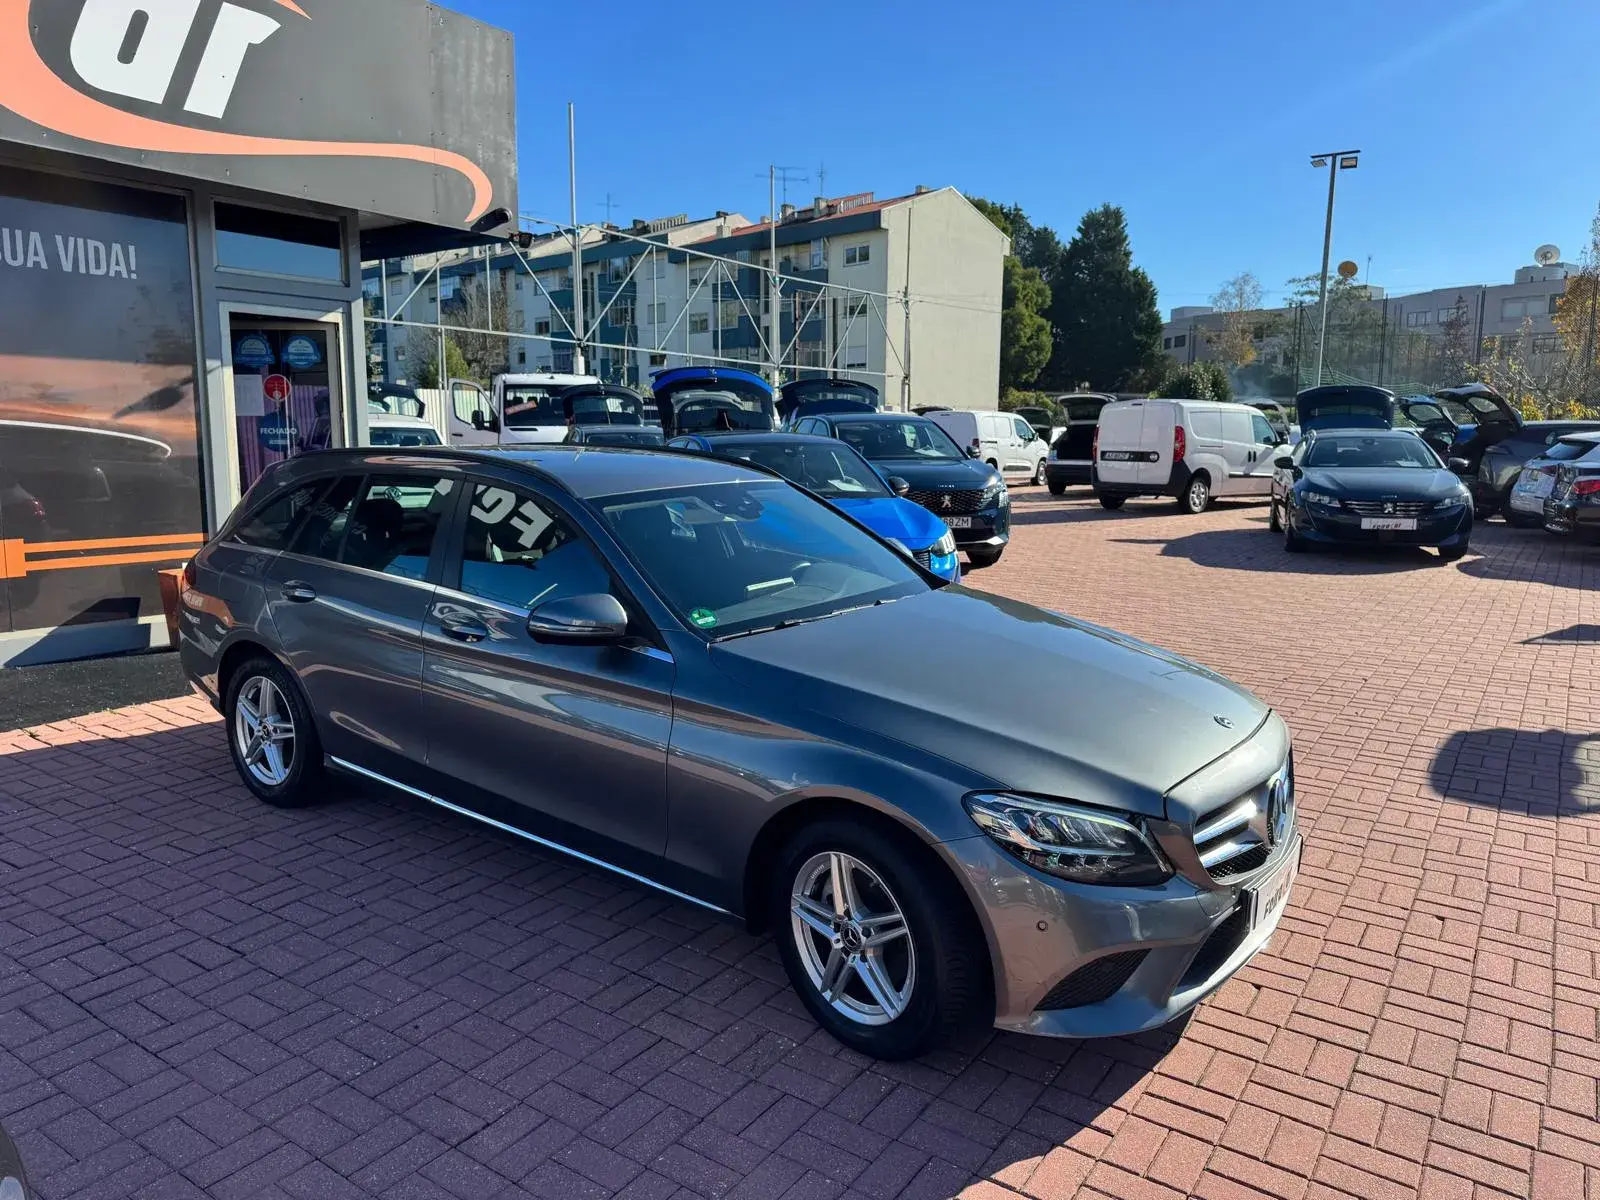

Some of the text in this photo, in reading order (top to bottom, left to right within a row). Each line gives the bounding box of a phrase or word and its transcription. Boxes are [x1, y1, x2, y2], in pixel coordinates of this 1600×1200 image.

[0, 228, 137, 280] UA VIDA!
[260, 427, 297, 435] FECHADO
